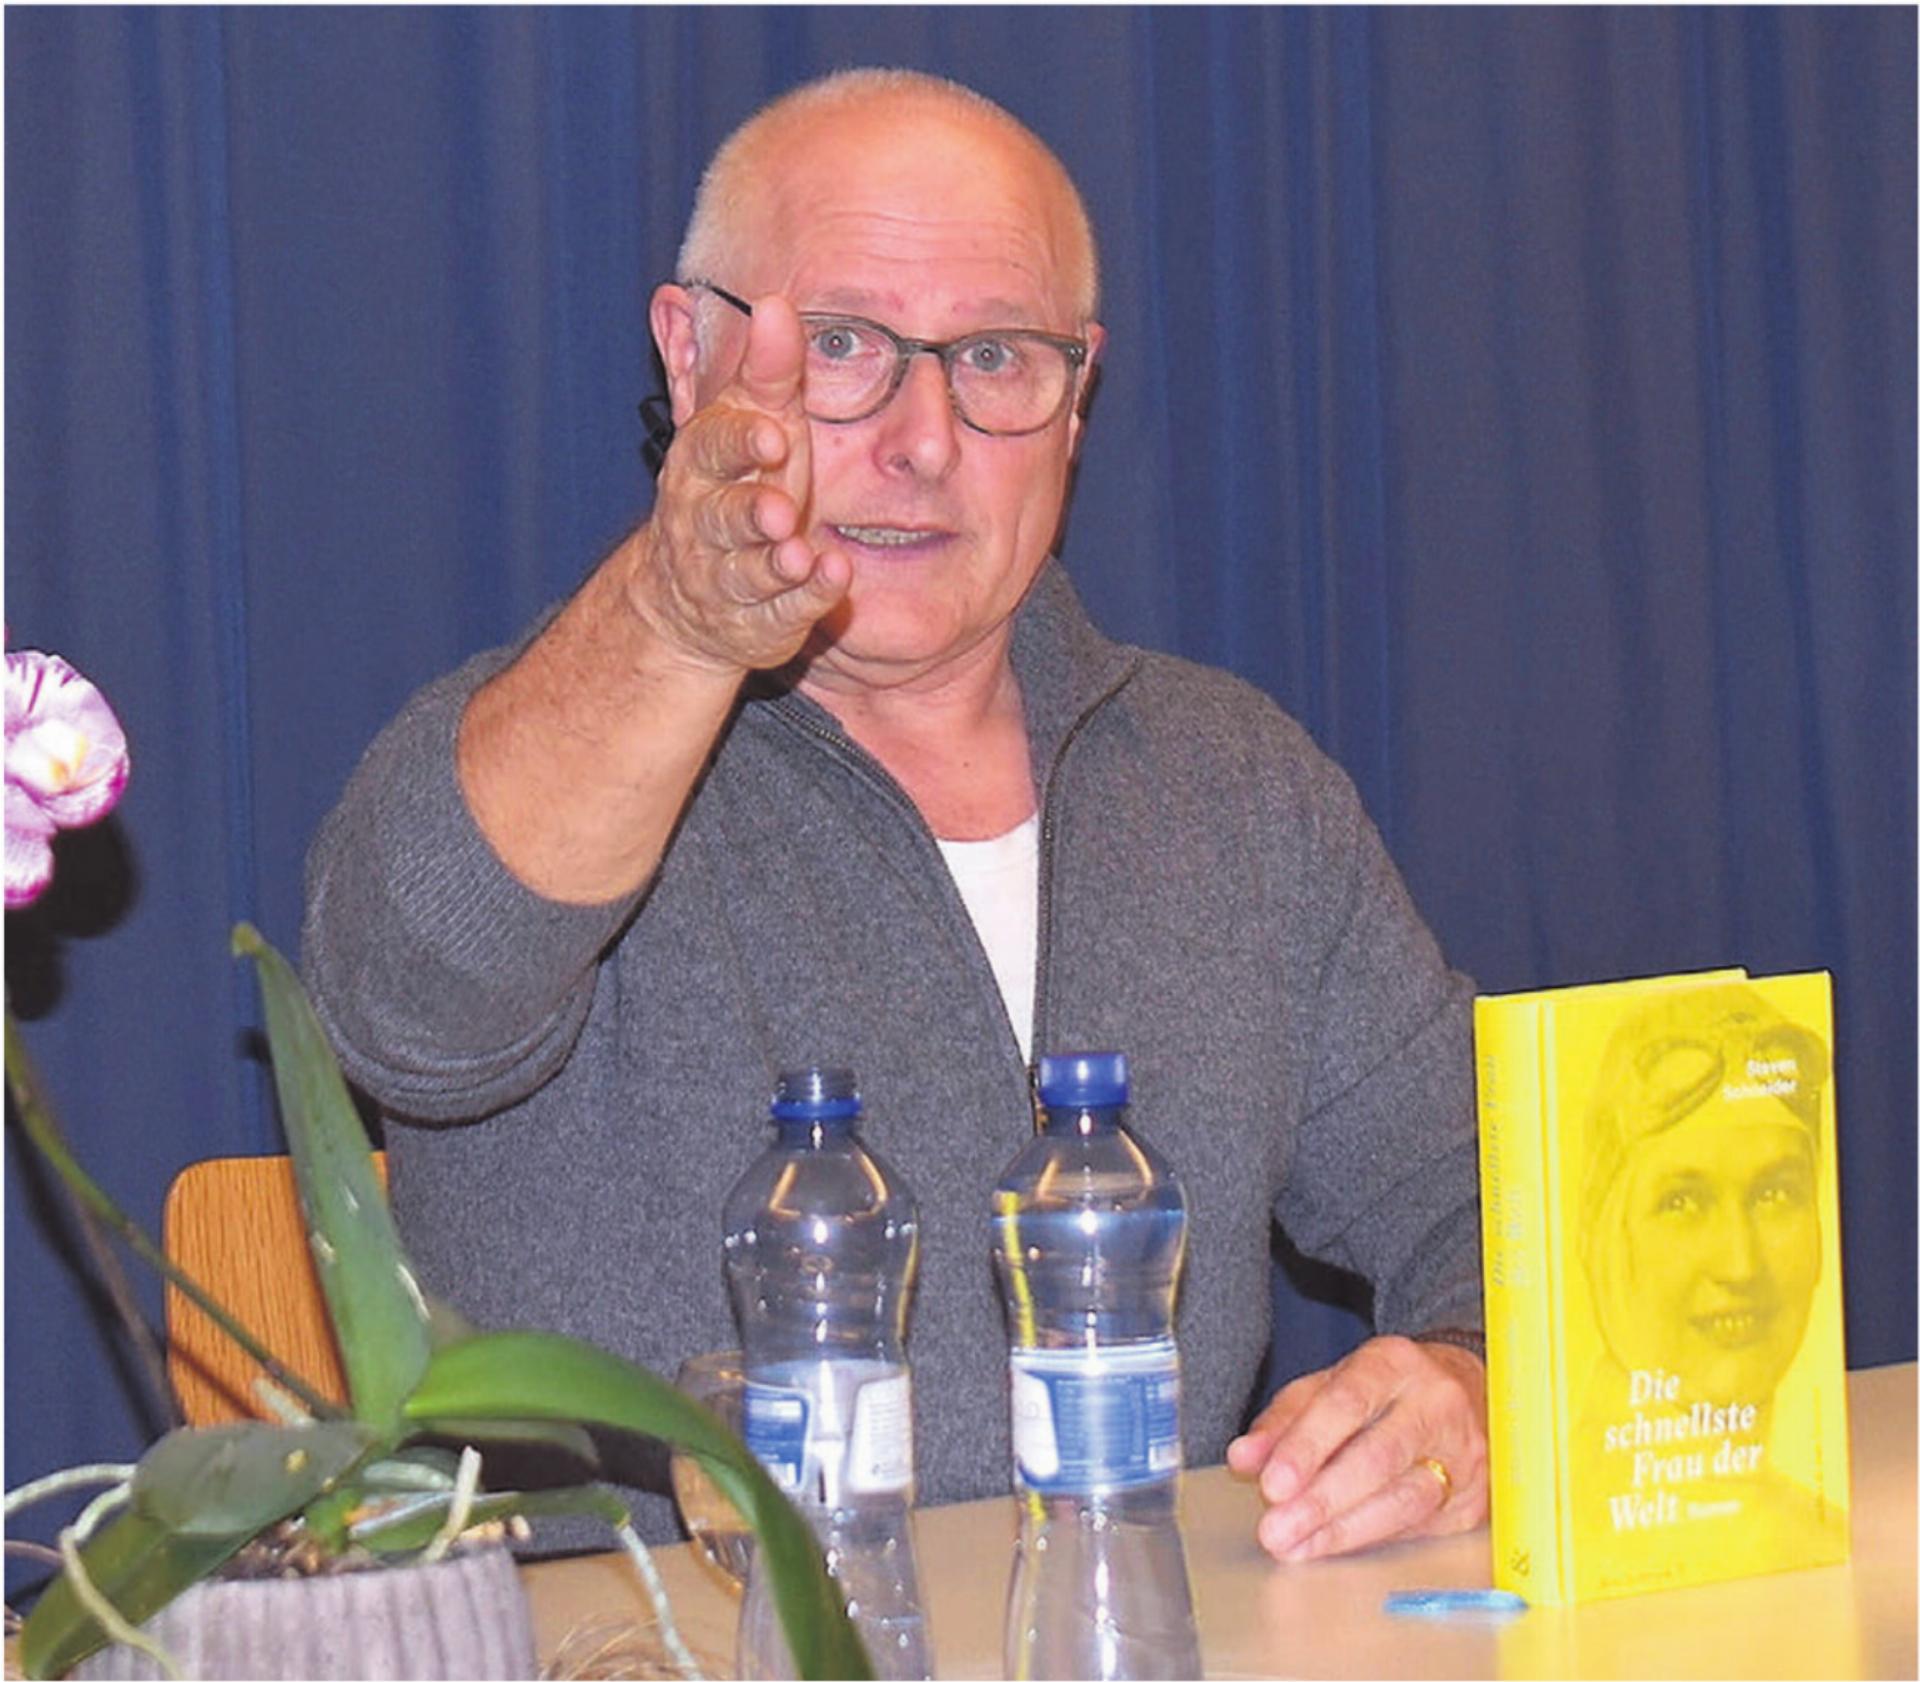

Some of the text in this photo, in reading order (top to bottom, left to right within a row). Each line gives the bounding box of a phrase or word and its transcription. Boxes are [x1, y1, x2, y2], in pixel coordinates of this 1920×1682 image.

[1629, 1369, 1680, 1406] Die
[1605, 1401, 1757, 1453] schnellste
[1632, 1440, 1763, 1488] Frau der
[1609, 1490, 1680, 1534] Welt
